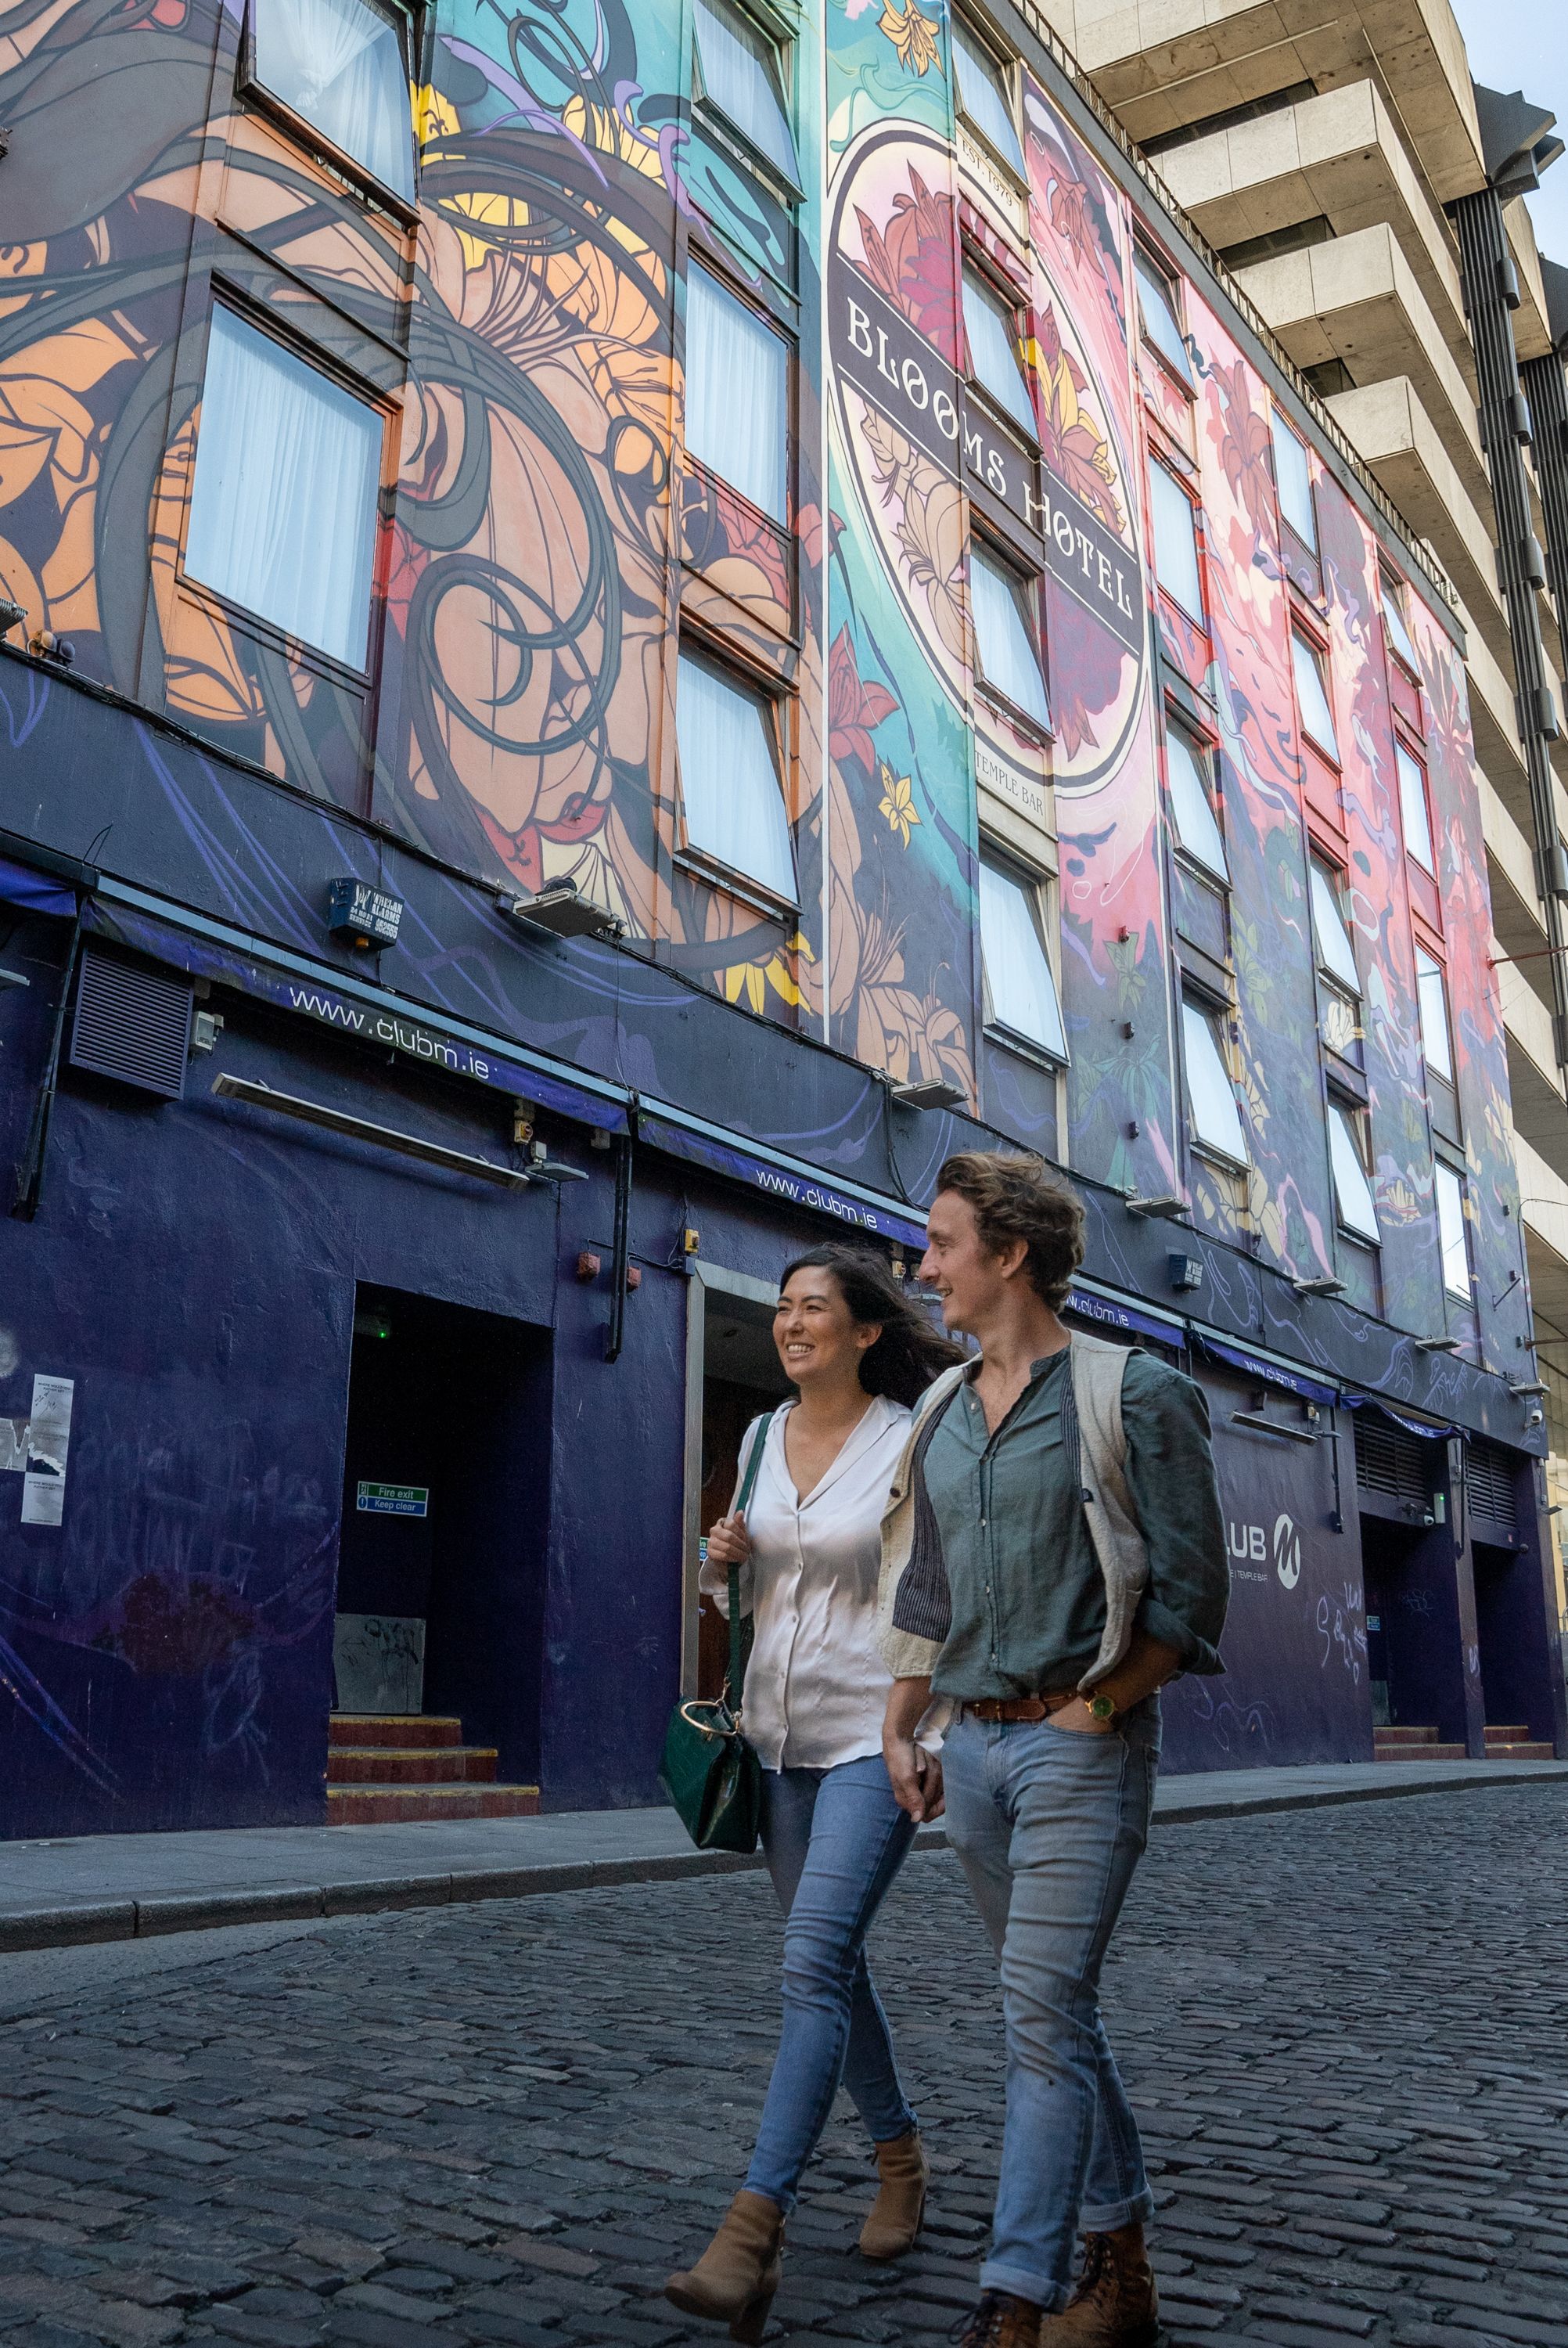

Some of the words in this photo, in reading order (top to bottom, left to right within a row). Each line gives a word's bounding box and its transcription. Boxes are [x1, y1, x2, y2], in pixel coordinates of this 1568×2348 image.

[988, 171, 1012, 207] 1979
[847, 296, 1007, 497] BLOOMS
[1023, 481, 1134, 621] HOTEL
[974, 750, 1019, 797] TEMPLE
[1022, 786, 1044, 816] BAR
[350, 906, 358, 915] 24
[372, 903, 401, 925] ALARMS
[290, 986, 489, 1080] www.clubm.ie
[756, 1169, 878, 1230] www.clubm.ie
[1066, 1294, 1130, 1327] w.clubm.ie
[375, 1500, 394, 1511] Keep
[395, 1502, 415, 1511] clear
[379, 1487, 395, 1497] Fire
[397, 1490, 414, 1499] exit
[1227, 1522, 1267, 1561] UB
